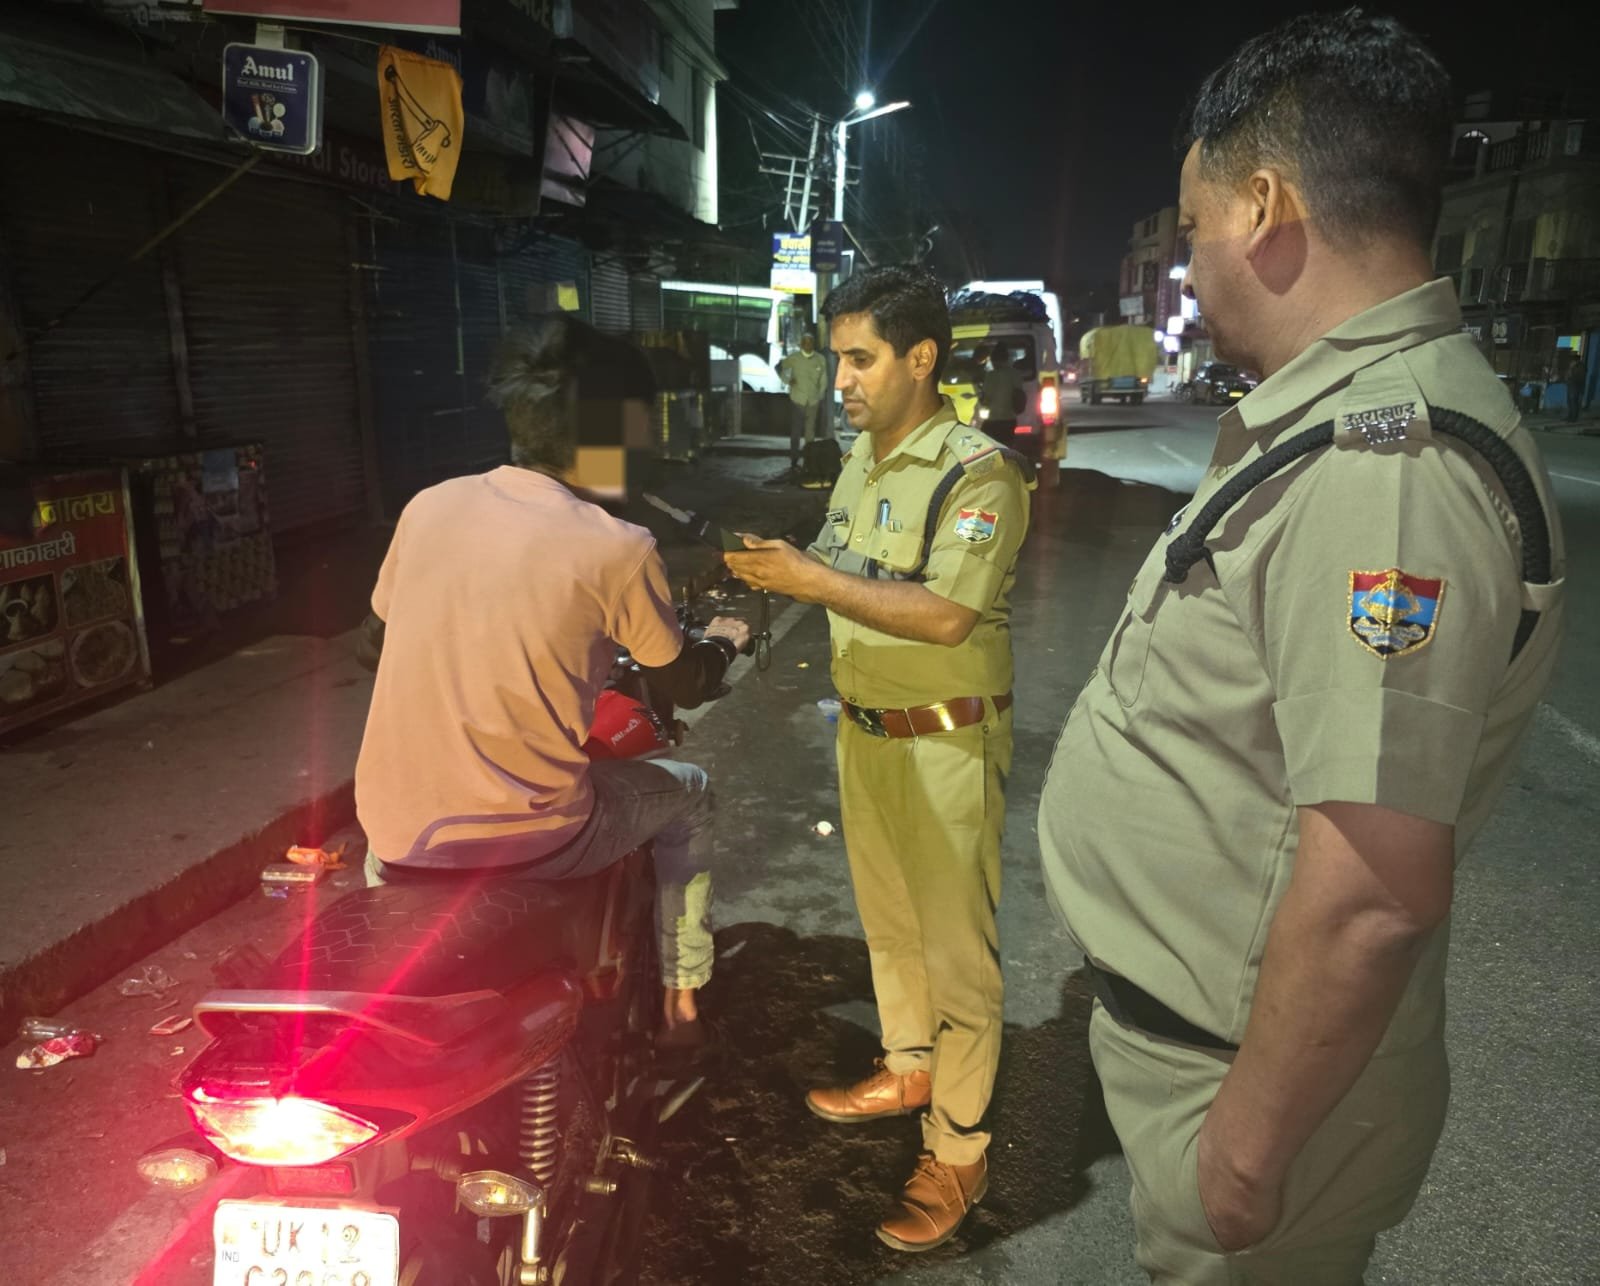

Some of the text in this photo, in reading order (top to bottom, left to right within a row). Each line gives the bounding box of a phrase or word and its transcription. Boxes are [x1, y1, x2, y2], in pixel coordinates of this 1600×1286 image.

[241, 55, 294, 81] Amul
[262, 1219, 305, 1257] UK
[221, 1250, 240, 1263] IND
